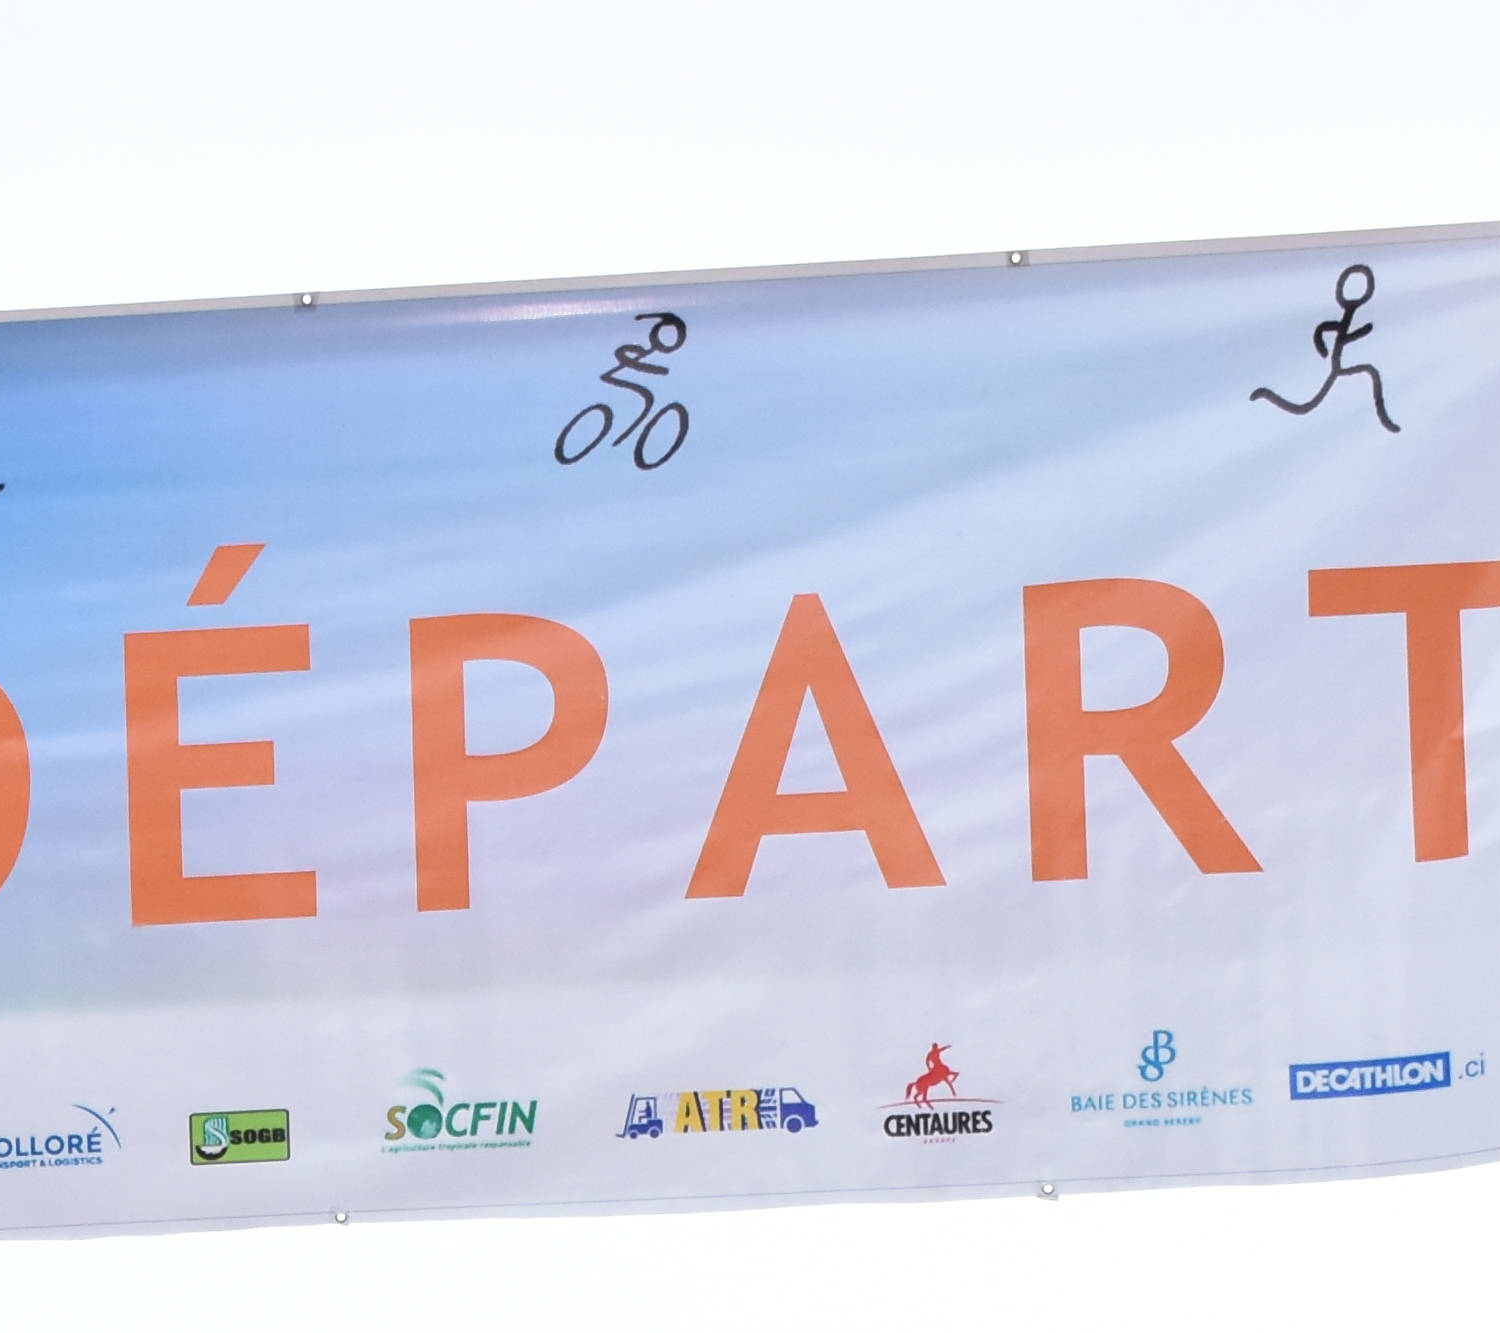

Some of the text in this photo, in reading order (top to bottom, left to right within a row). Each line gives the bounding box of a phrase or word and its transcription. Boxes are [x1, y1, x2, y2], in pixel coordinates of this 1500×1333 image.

[1295, 1058, 1446, 1094] DECATHLON
[674, 1088, 763, 1134] ATR
[1070, 1086, 1254, 1113] BAIE DES SIRÈNES
[229, 1126, 286, 1145] SOGB
[384, 1099, 538, 1142] SOCFIN
[48, 1156, 103, 1167] LOGISTICS
